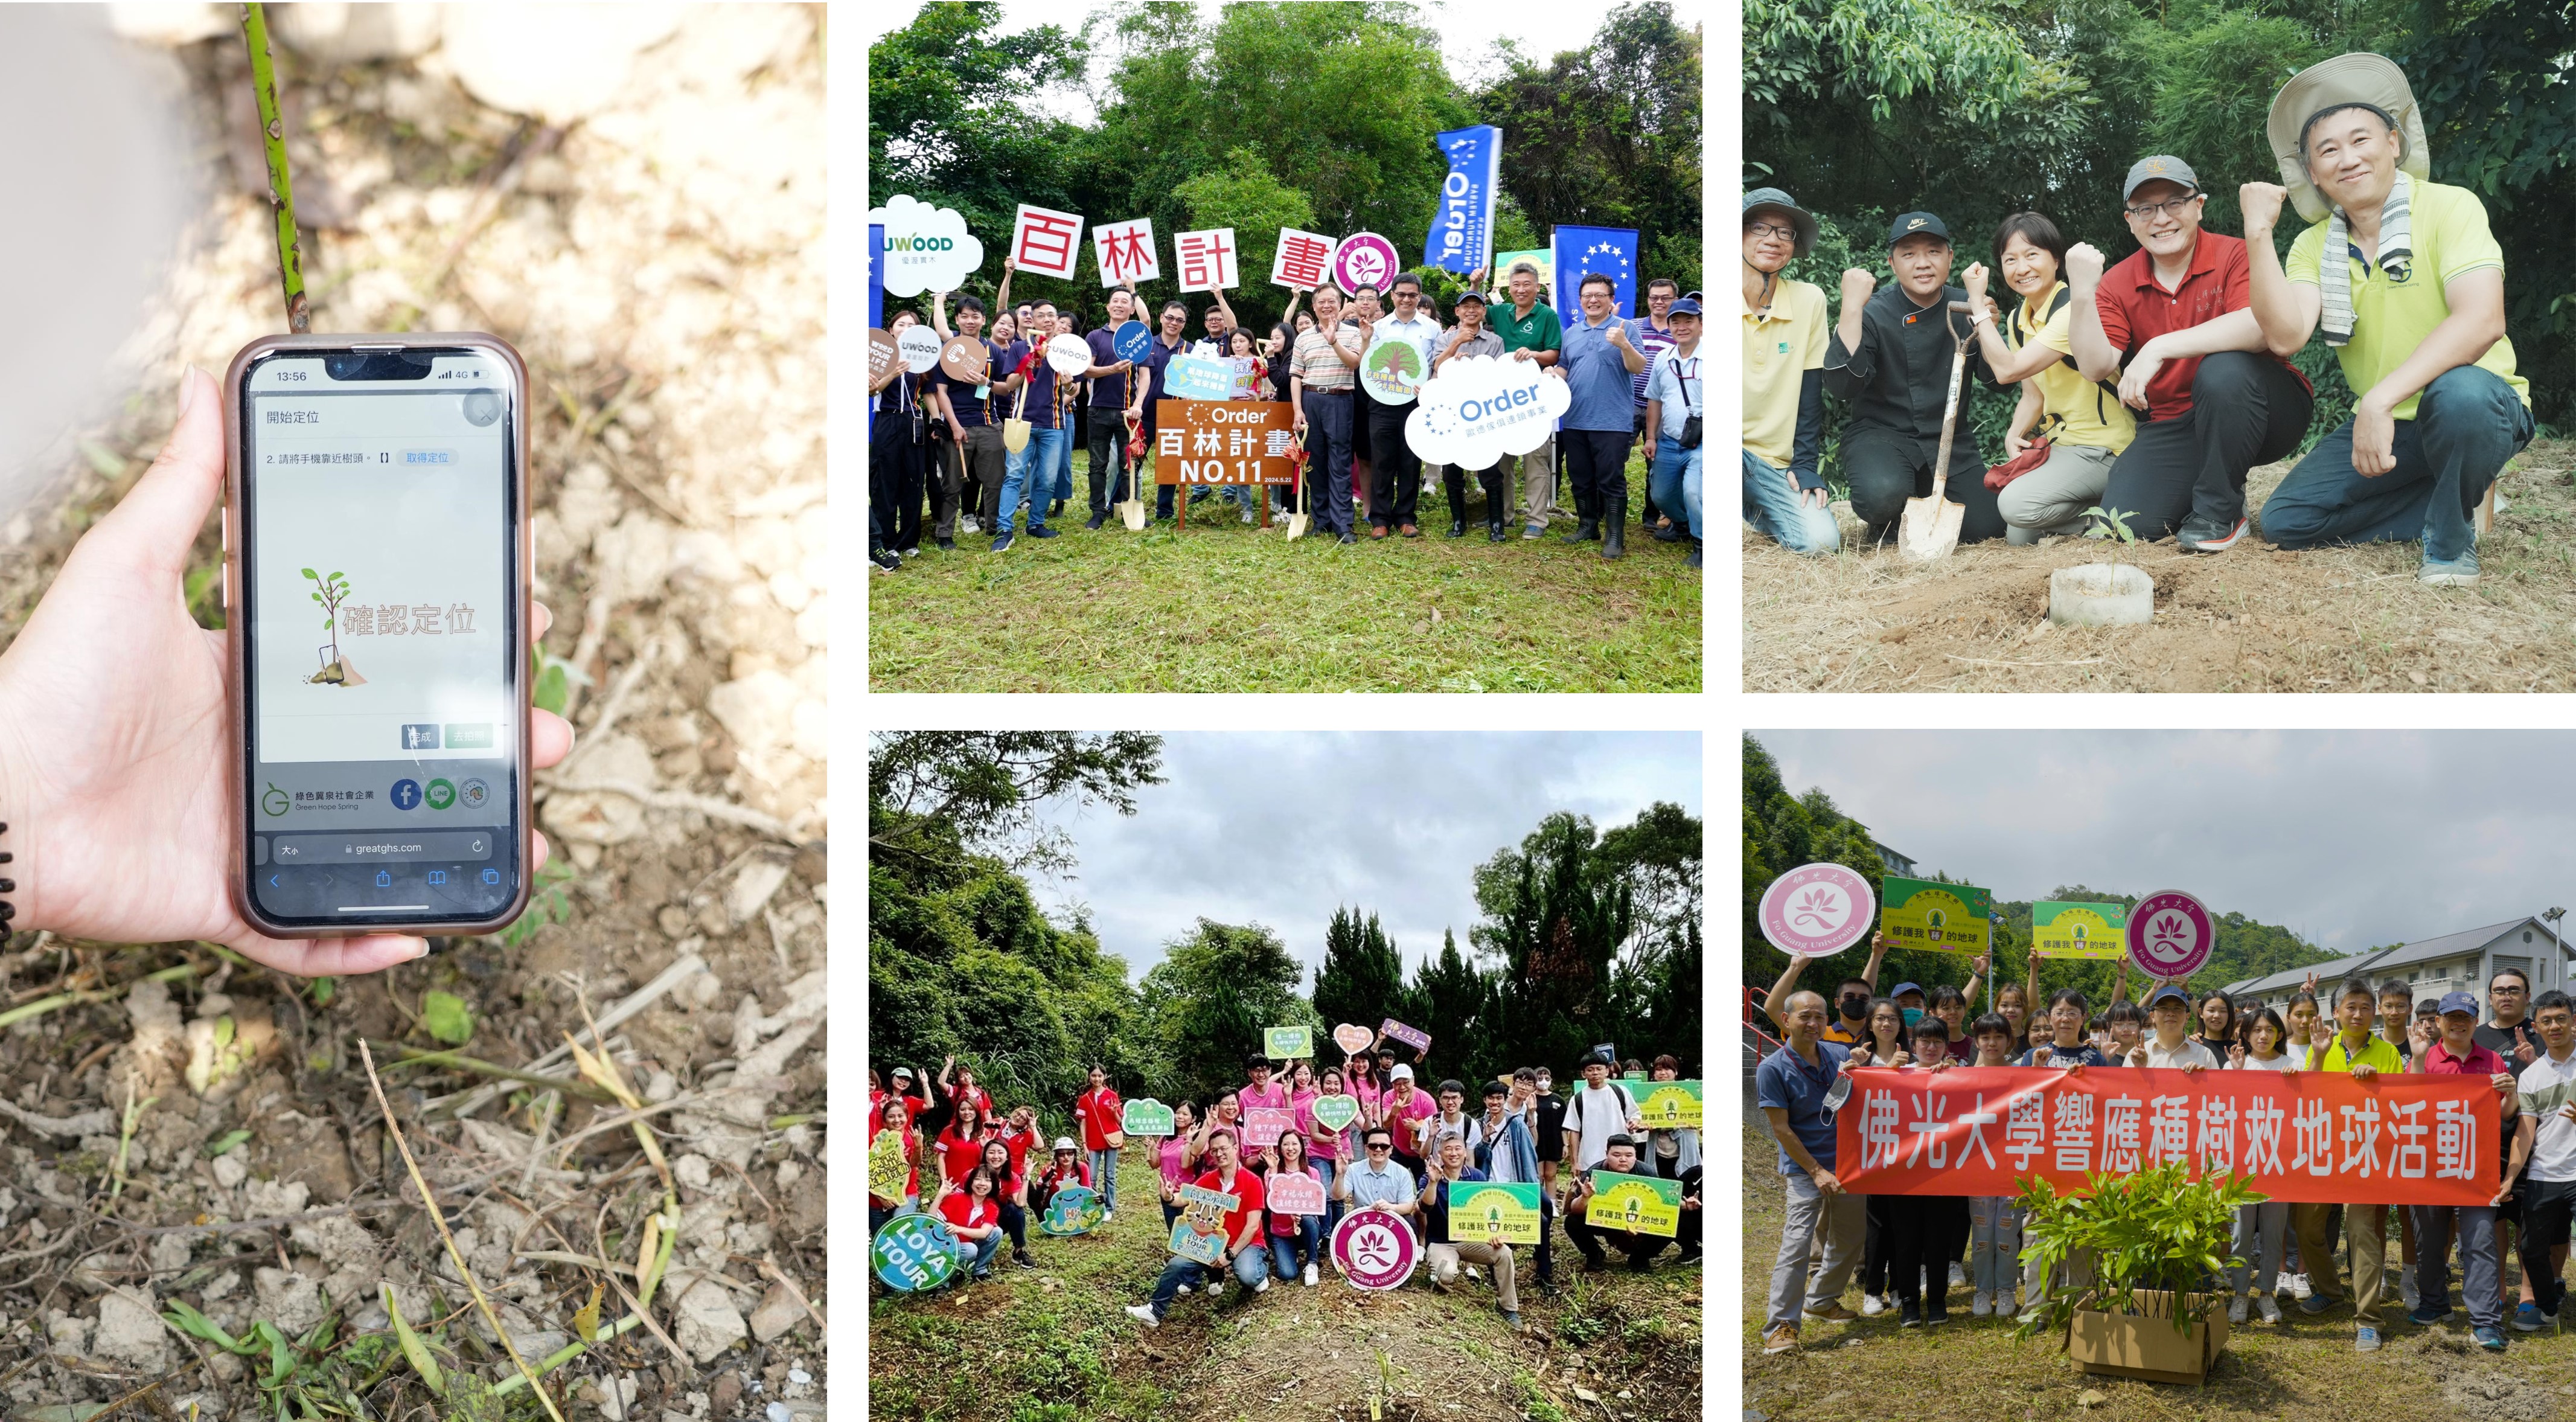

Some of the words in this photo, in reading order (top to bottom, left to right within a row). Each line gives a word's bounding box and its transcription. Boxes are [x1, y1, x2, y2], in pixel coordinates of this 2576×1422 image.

[880, 237, 953, 251] UWOOD
[1019, 212, 1076, 271] 百
[1101, 227, 1152, 279] 林
[1181, 234, 1230, 286] 計
[1276, 237, 1329, 287] 畫
[1381, 260, 1393, 287] University
[1127, 329, 1146, 348] Order
[902, 342, 938, 354] UWOOD
[1052, 345, 1088, 361] UWOOD
[869, 357, 888, 368] IFE
[963, 358, 977, 369] CIAO
[276, 372, 307, 381] 13:56
[1460, 383, 1539, 421] Order
[266, 411, 319, 424] 開始定位
[1212, 408, 1267, 423] Order
[1466, 405, 1547, 438] 歐德傢俱連鎖事業
[1158, 428, 1292, 457] 百林計畫
[267, 455, 275, 464] 2.
[406, 452, 449, 463] 取得定位
[1180, 460, 1261, 482] NO.11
[343, 603, 476, 635] 確認定位
[454, 731, 485, 741] 去拍照
[282, 845, 298, 855] 大小
[356, 843, 421, 854] greatghs.com
[1772, 920, 1781, 930] Fo
[1780, 931, 1808, 949] Guang
[1811, 924, 1857, 948] University
[1893, 926, 1925, 938] 修護我
[1931, 930, 1940, 940] 種
[1947, 931, 1978, 943] 的地球
[2043, 940, 2071, 949] 修護我
[2089, 941, 2117, 950] 的地球
[2137, 949, 2146, 959] Fo
[2145, 959, 2169, 974] Guang
[2171, 948, 2204, 973] University
[1858, 1089, 2476, 1180] 佛光大學響應種樹救地球活動
[1064, 1207, 1081, 1219] Hi
[1596, 1209, 1622, 1220] 修護我
[1641, 1215, 1669, 1226] 的地球
[1458, 1222, 1485, 1231] 修護我
[1504, 1223, 1531, 1232] 的地球
[1187, 1232, 1208, 1244] LOYA
[1187, 1240, 1206, 1250] TOUR
[896, 1222, 947, 1273] LOYA
[878, 1237, 929, 1289] TOUR
[1351, 1271, 1374, 1285] Guang
[1376, 1260, 1407, 1284] University
